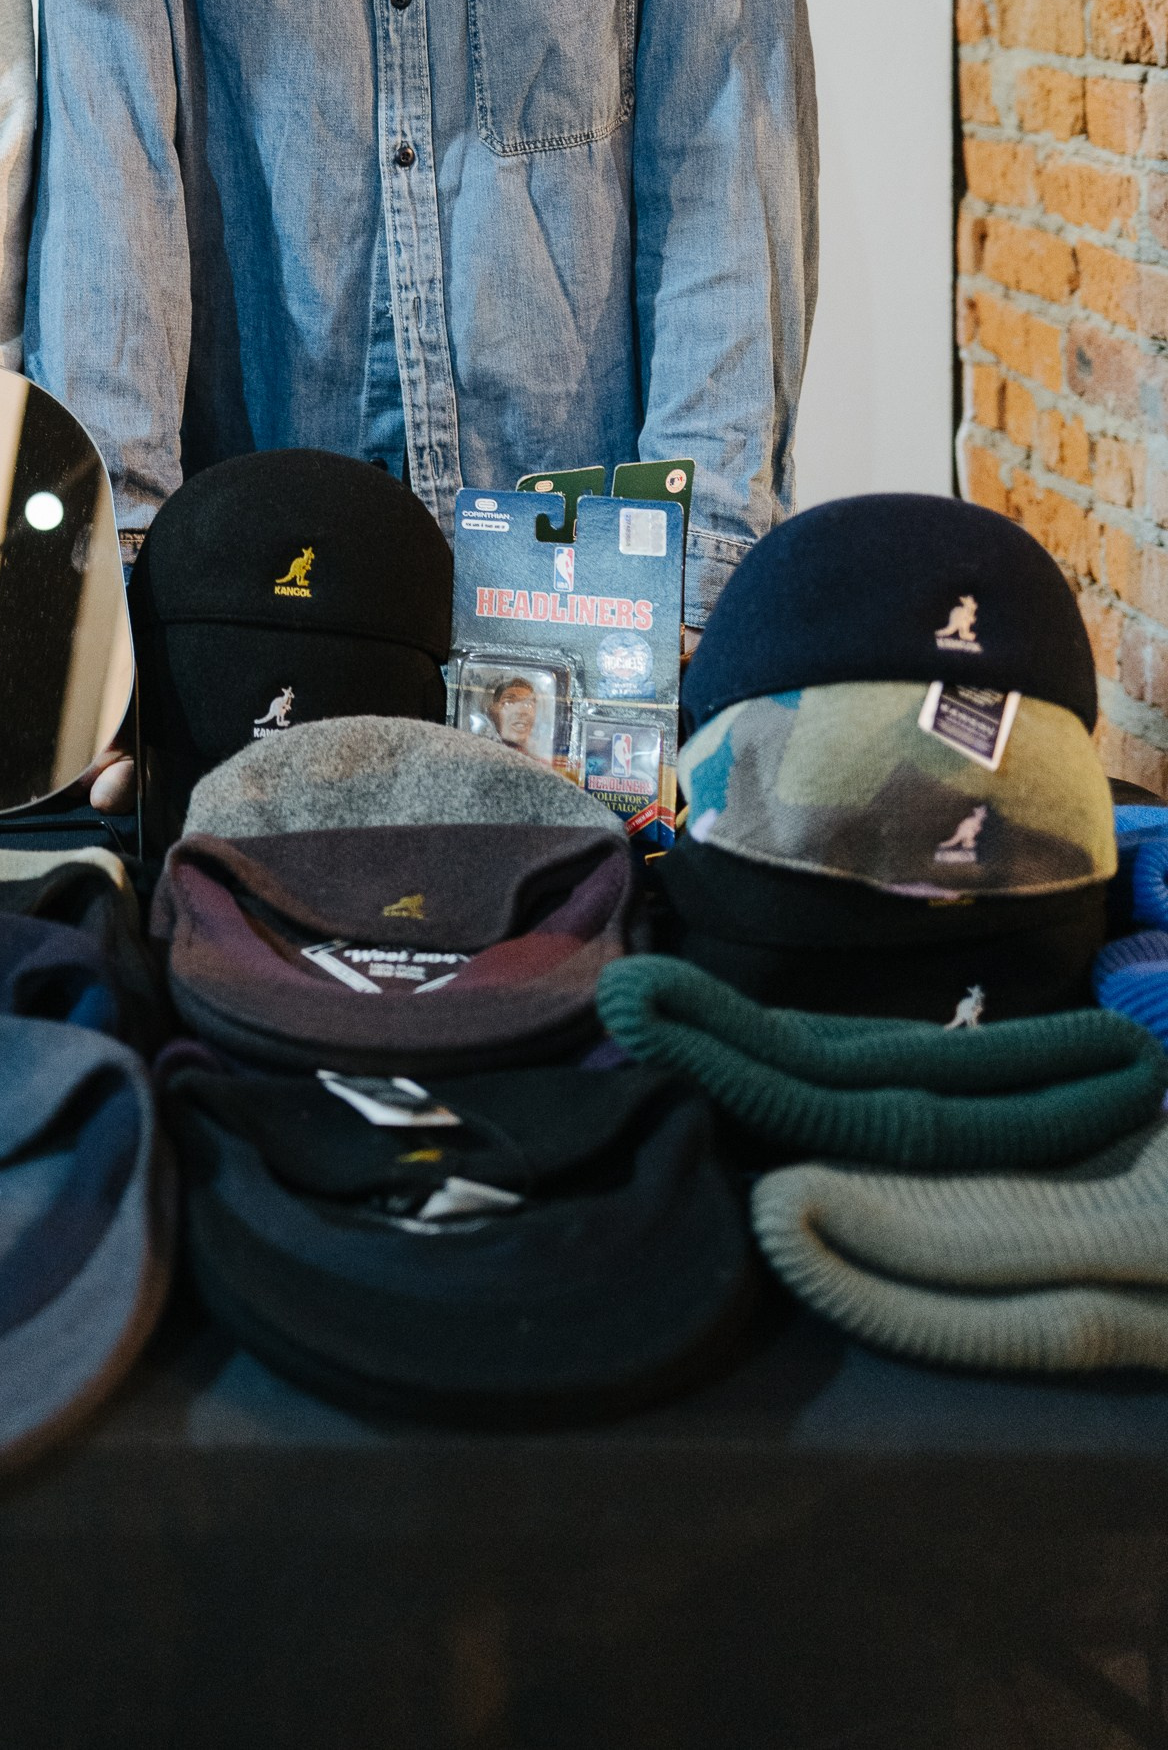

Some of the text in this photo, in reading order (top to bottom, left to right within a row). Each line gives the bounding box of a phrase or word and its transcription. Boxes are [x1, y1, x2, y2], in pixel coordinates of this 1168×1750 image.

[462, 510, 511, 521] CORINTHIAN
[274, 585, 312, 598] KANGOL
[476, 587, 654, 631] HEADLINERS
[588, 775, 653, 796] HEADLINERS
